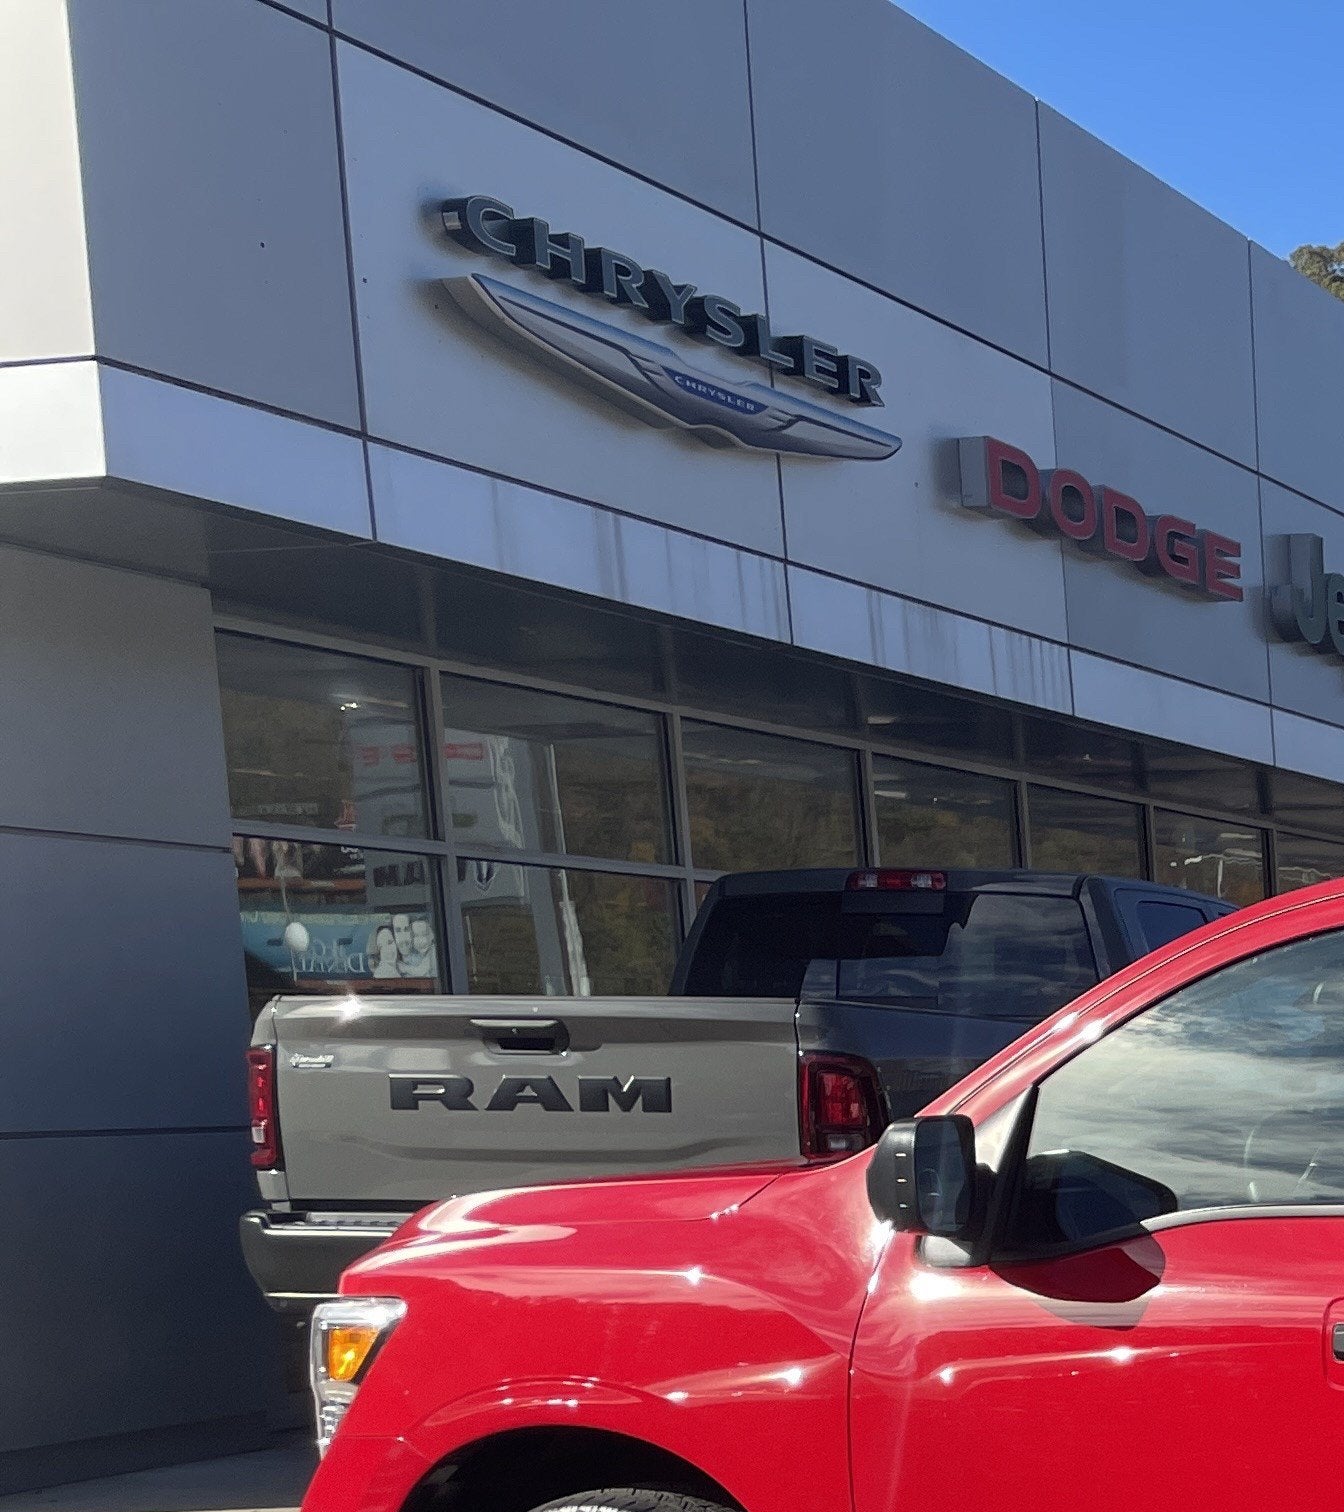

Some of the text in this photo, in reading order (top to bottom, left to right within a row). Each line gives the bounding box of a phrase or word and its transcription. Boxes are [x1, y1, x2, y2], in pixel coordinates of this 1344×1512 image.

[454, 196, 884, 406] CHRYSLER
[674, 376, 755, 411] CHRYSLER
[974, 437, 1243, 600] DODGE
[388, 1074, 673, 1114] RAM
